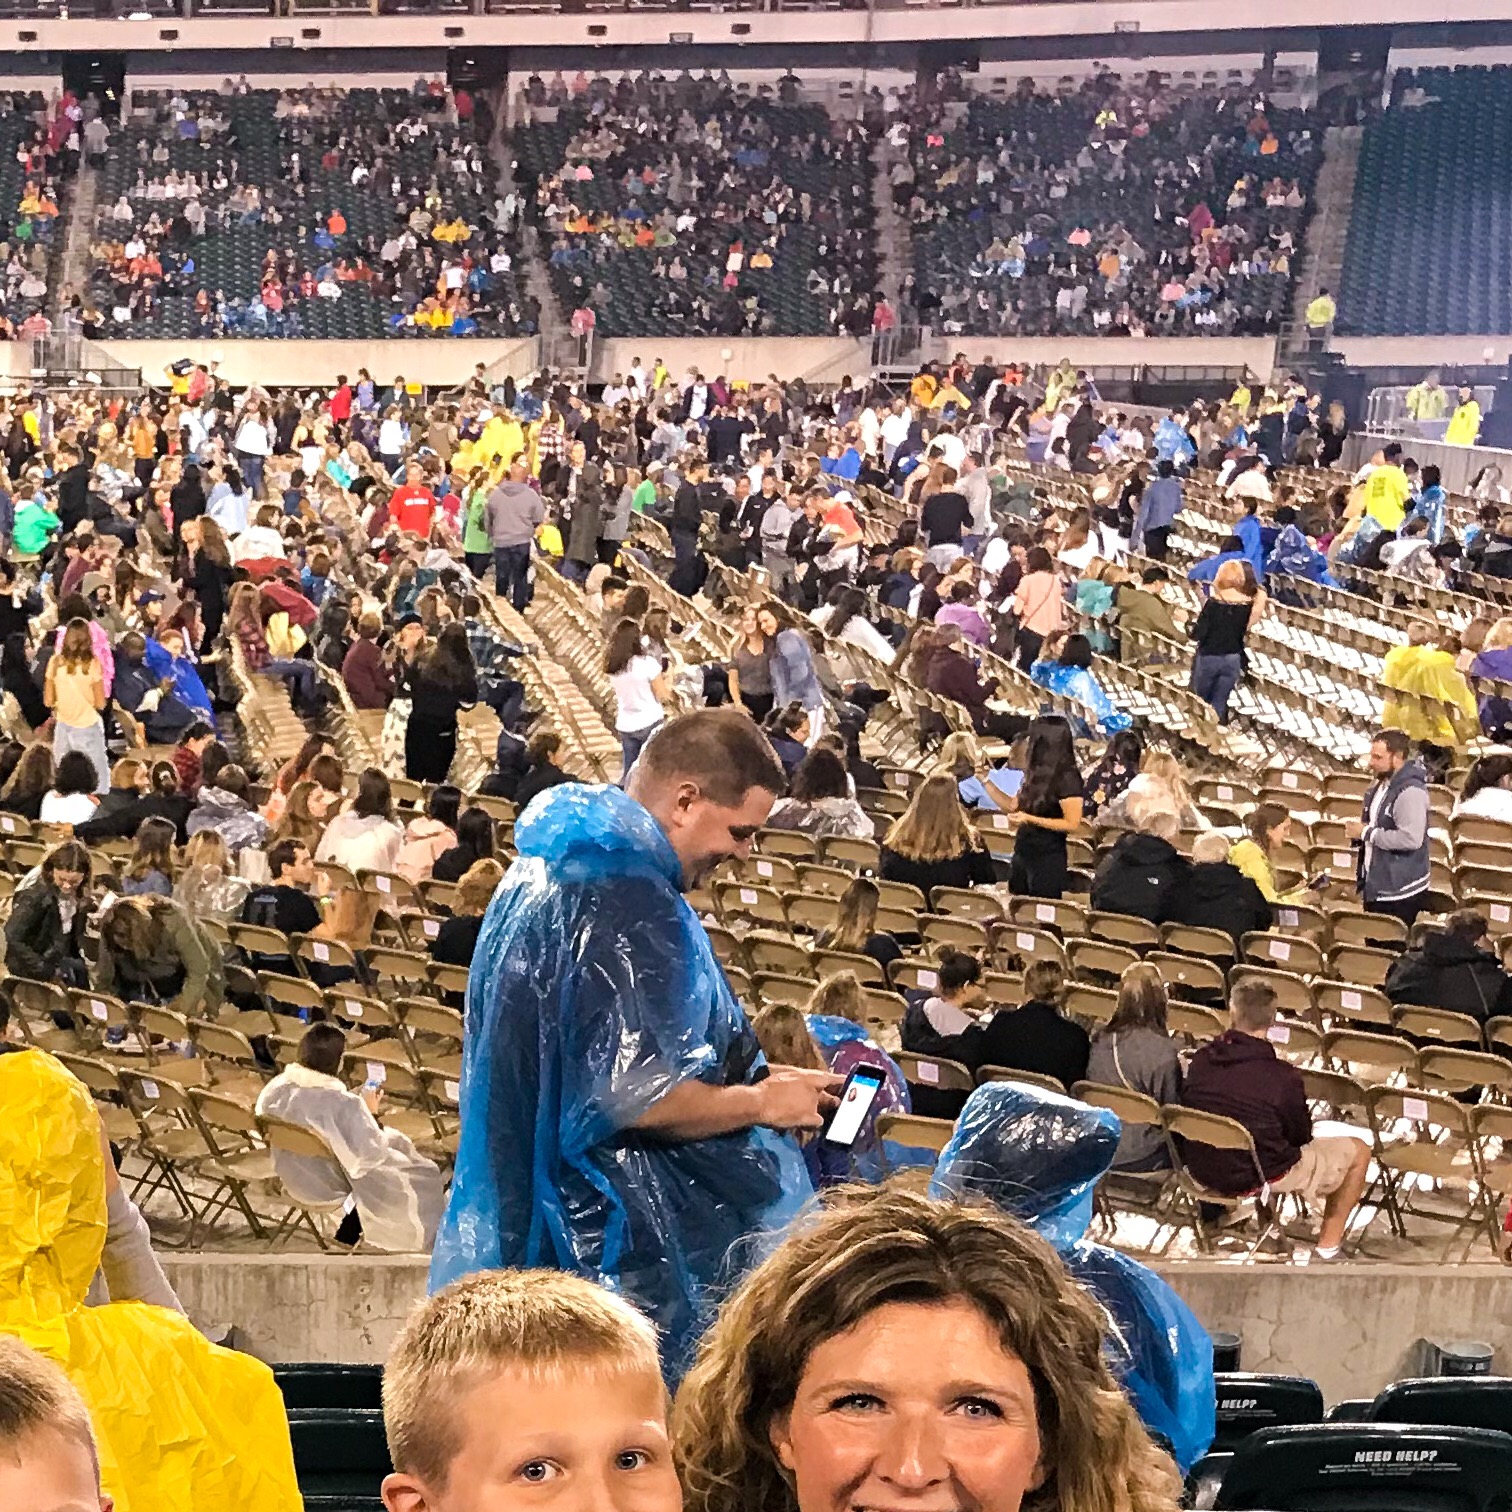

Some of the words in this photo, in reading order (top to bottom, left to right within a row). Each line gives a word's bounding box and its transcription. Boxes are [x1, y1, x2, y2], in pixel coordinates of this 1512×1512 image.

[1221, 1399, 1258, 1409] HELP?
[1354, 1451, 1392, 1462] NEED
[1395, 1450, 1438, 1461] HELP?
